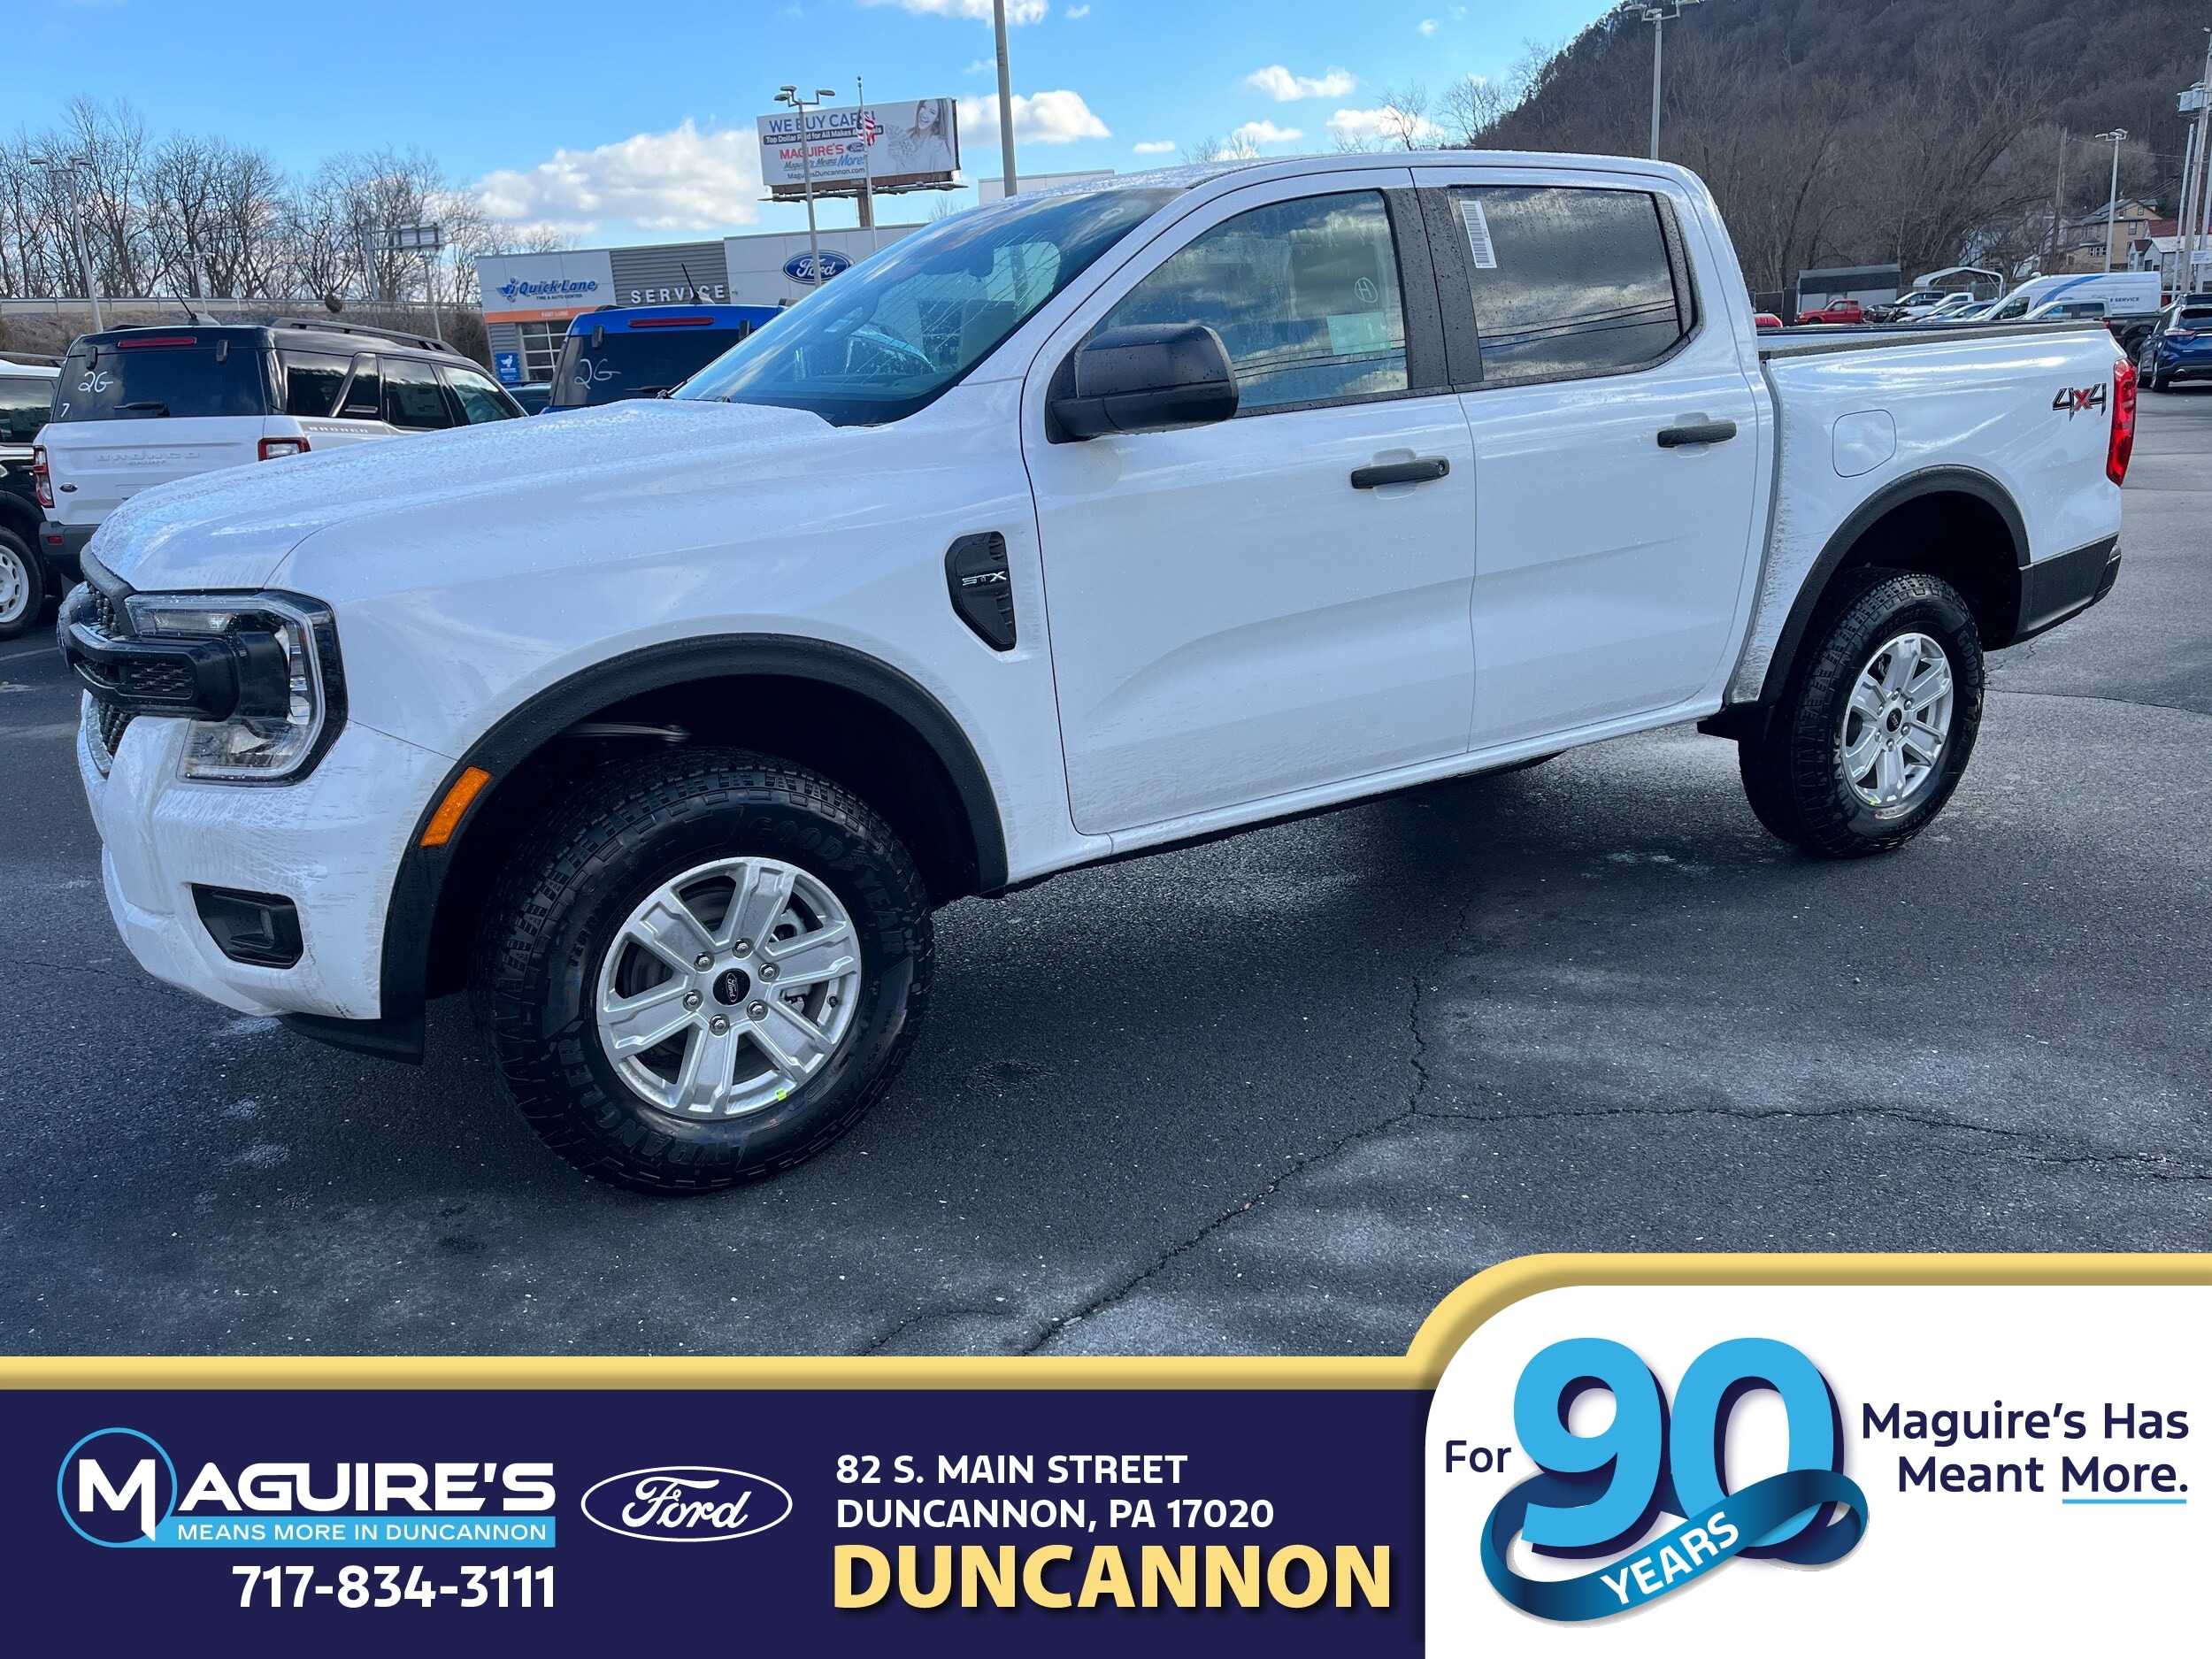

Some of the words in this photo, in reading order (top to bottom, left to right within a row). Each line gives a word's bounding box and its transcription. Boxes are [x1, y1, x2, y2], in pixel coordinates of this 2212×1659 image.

[769, 119, 793, 133] WE
[829, 111, 876, 127] CAR!
[780, 143, 844, 159] MAGUIRE'S
[784, 159, 815, 171] Magu's
[787, 168, 865, 180] MaguesDuncannon.com
[518, 280, 559, 296] Quick
[561, 280, 596, 293] Lane
[631, 285, 725, 303] SERVICE
[962, 571, 1007, 586] STX
